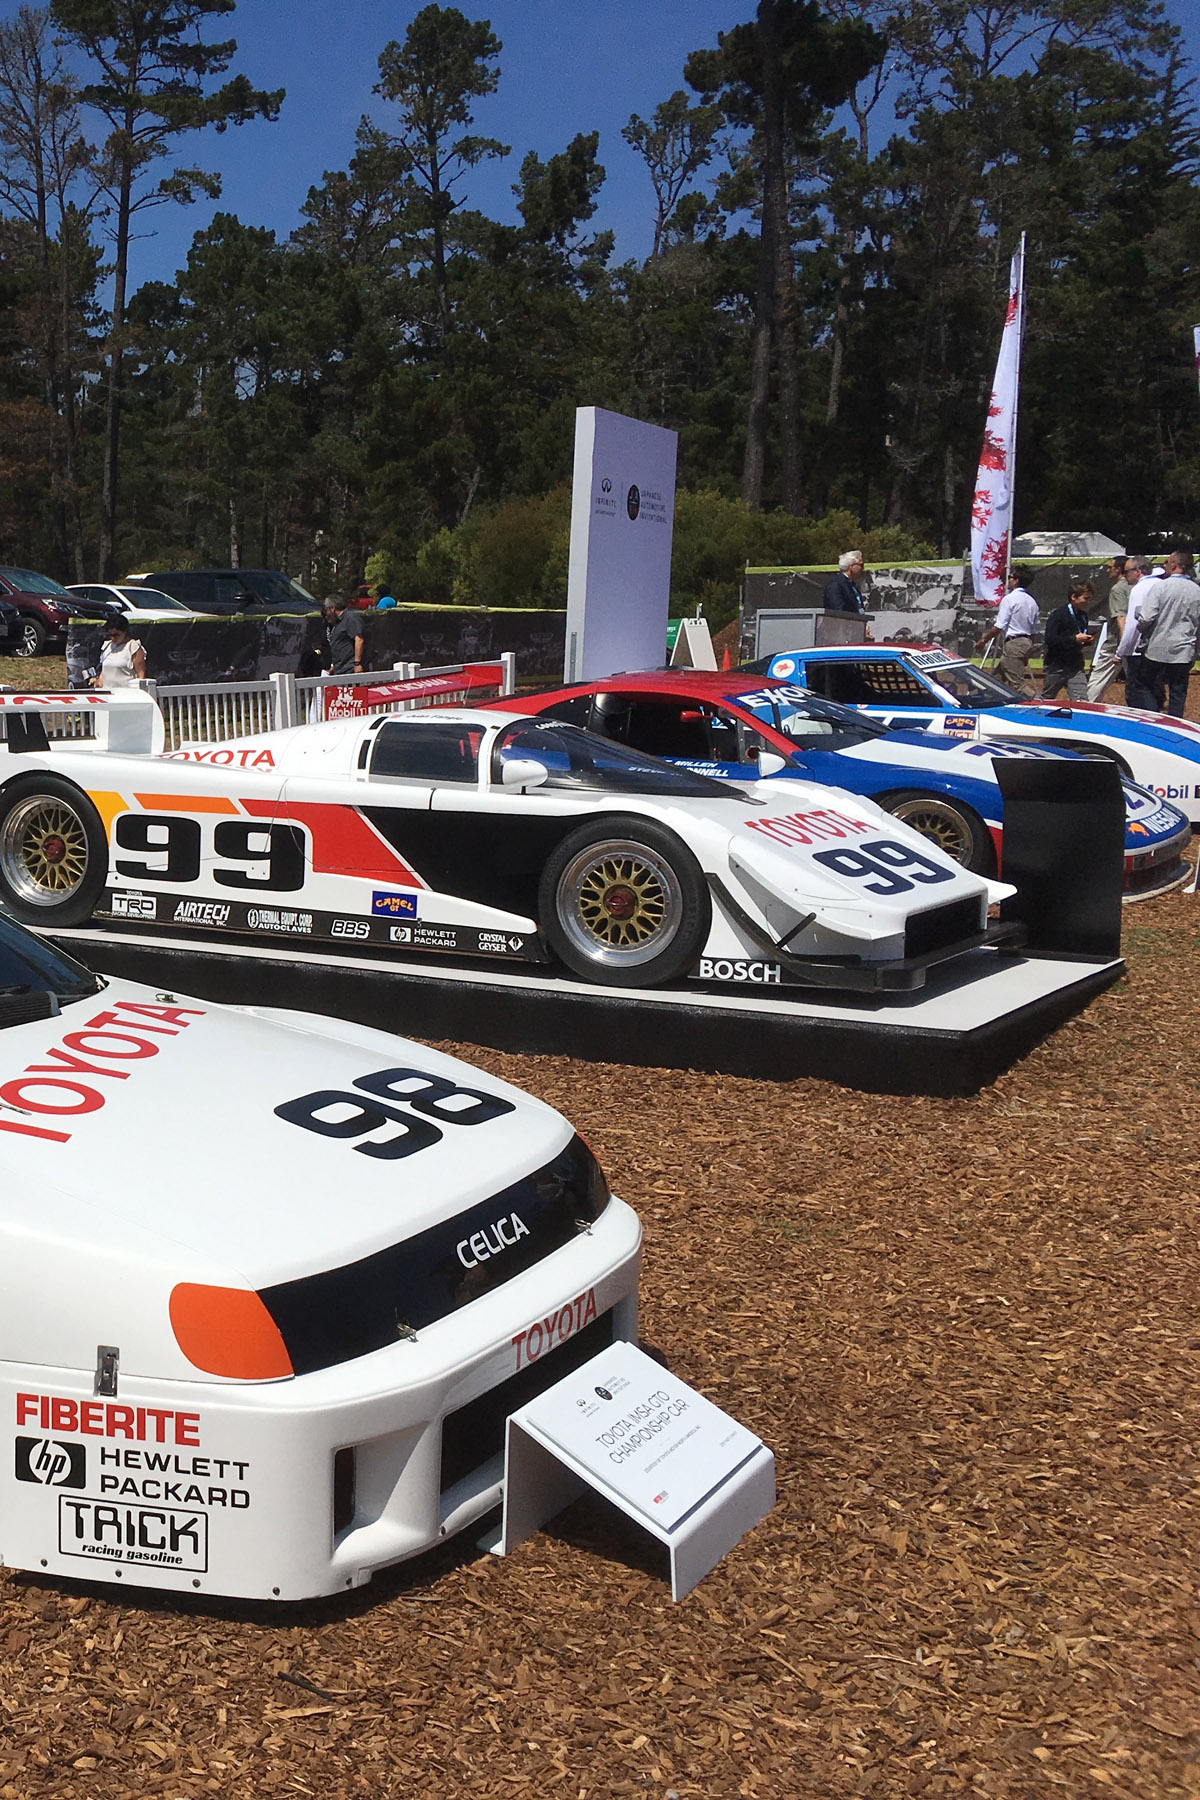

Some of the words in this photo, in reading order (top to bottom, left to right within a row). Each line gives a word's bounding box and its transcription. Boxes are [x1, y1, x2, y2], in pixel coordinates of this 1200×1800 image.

[736, 685, 817, 707] EXXON
[329, 707, 356, 719] Mobil
[744, 809, 881, 848] TOYOTA
[115, 813, 306, 893] 99
[812, 840, 957, 896] 99
[114, 897, 154, 914] TRD
[174, 900, 231, 921] AIRTECH
[375, 897, 414, 912] CAMEL
[173, 916, 215, 926] INTERNATIONAL
[258, 922, 312, 934] AUTOCLAVES
[331, 919, 371, 939] BBS
[414, 928, 457, 939] HEWLETT
[414, 936, 457, 948] PACKARD
[478, 932, 507, 944] CRYSTAL
[478, 941, 507, 952] GEYSER
[699, 959, 781, 983] BOSCH
[273, 1067, 517, 1161] 98
[456, 1212, 531, 1269] CELICA
[512, 1287, 598, 1371] TOYOTA
[16, 1392, 201, 1447] FIBERITE
[595, 1419, 636, 1449] TOYOTA
[627, 1403, 656, 1425] IMSA
[648, 1390, 671, 1409] GTO
[609, 1411, 673, 1464] CHAMPIONSHIP
[667, 1398, 692, 1418] CAR
[100, 1446, 250, 1481] HEWLETT
[100, 1474, 250, 1509] PACKARD
[65, 1500, 199, 1555] TRICK
[81, 1542, 123, 1560] racing
[126, 1548, 184, 1565] gasoline
